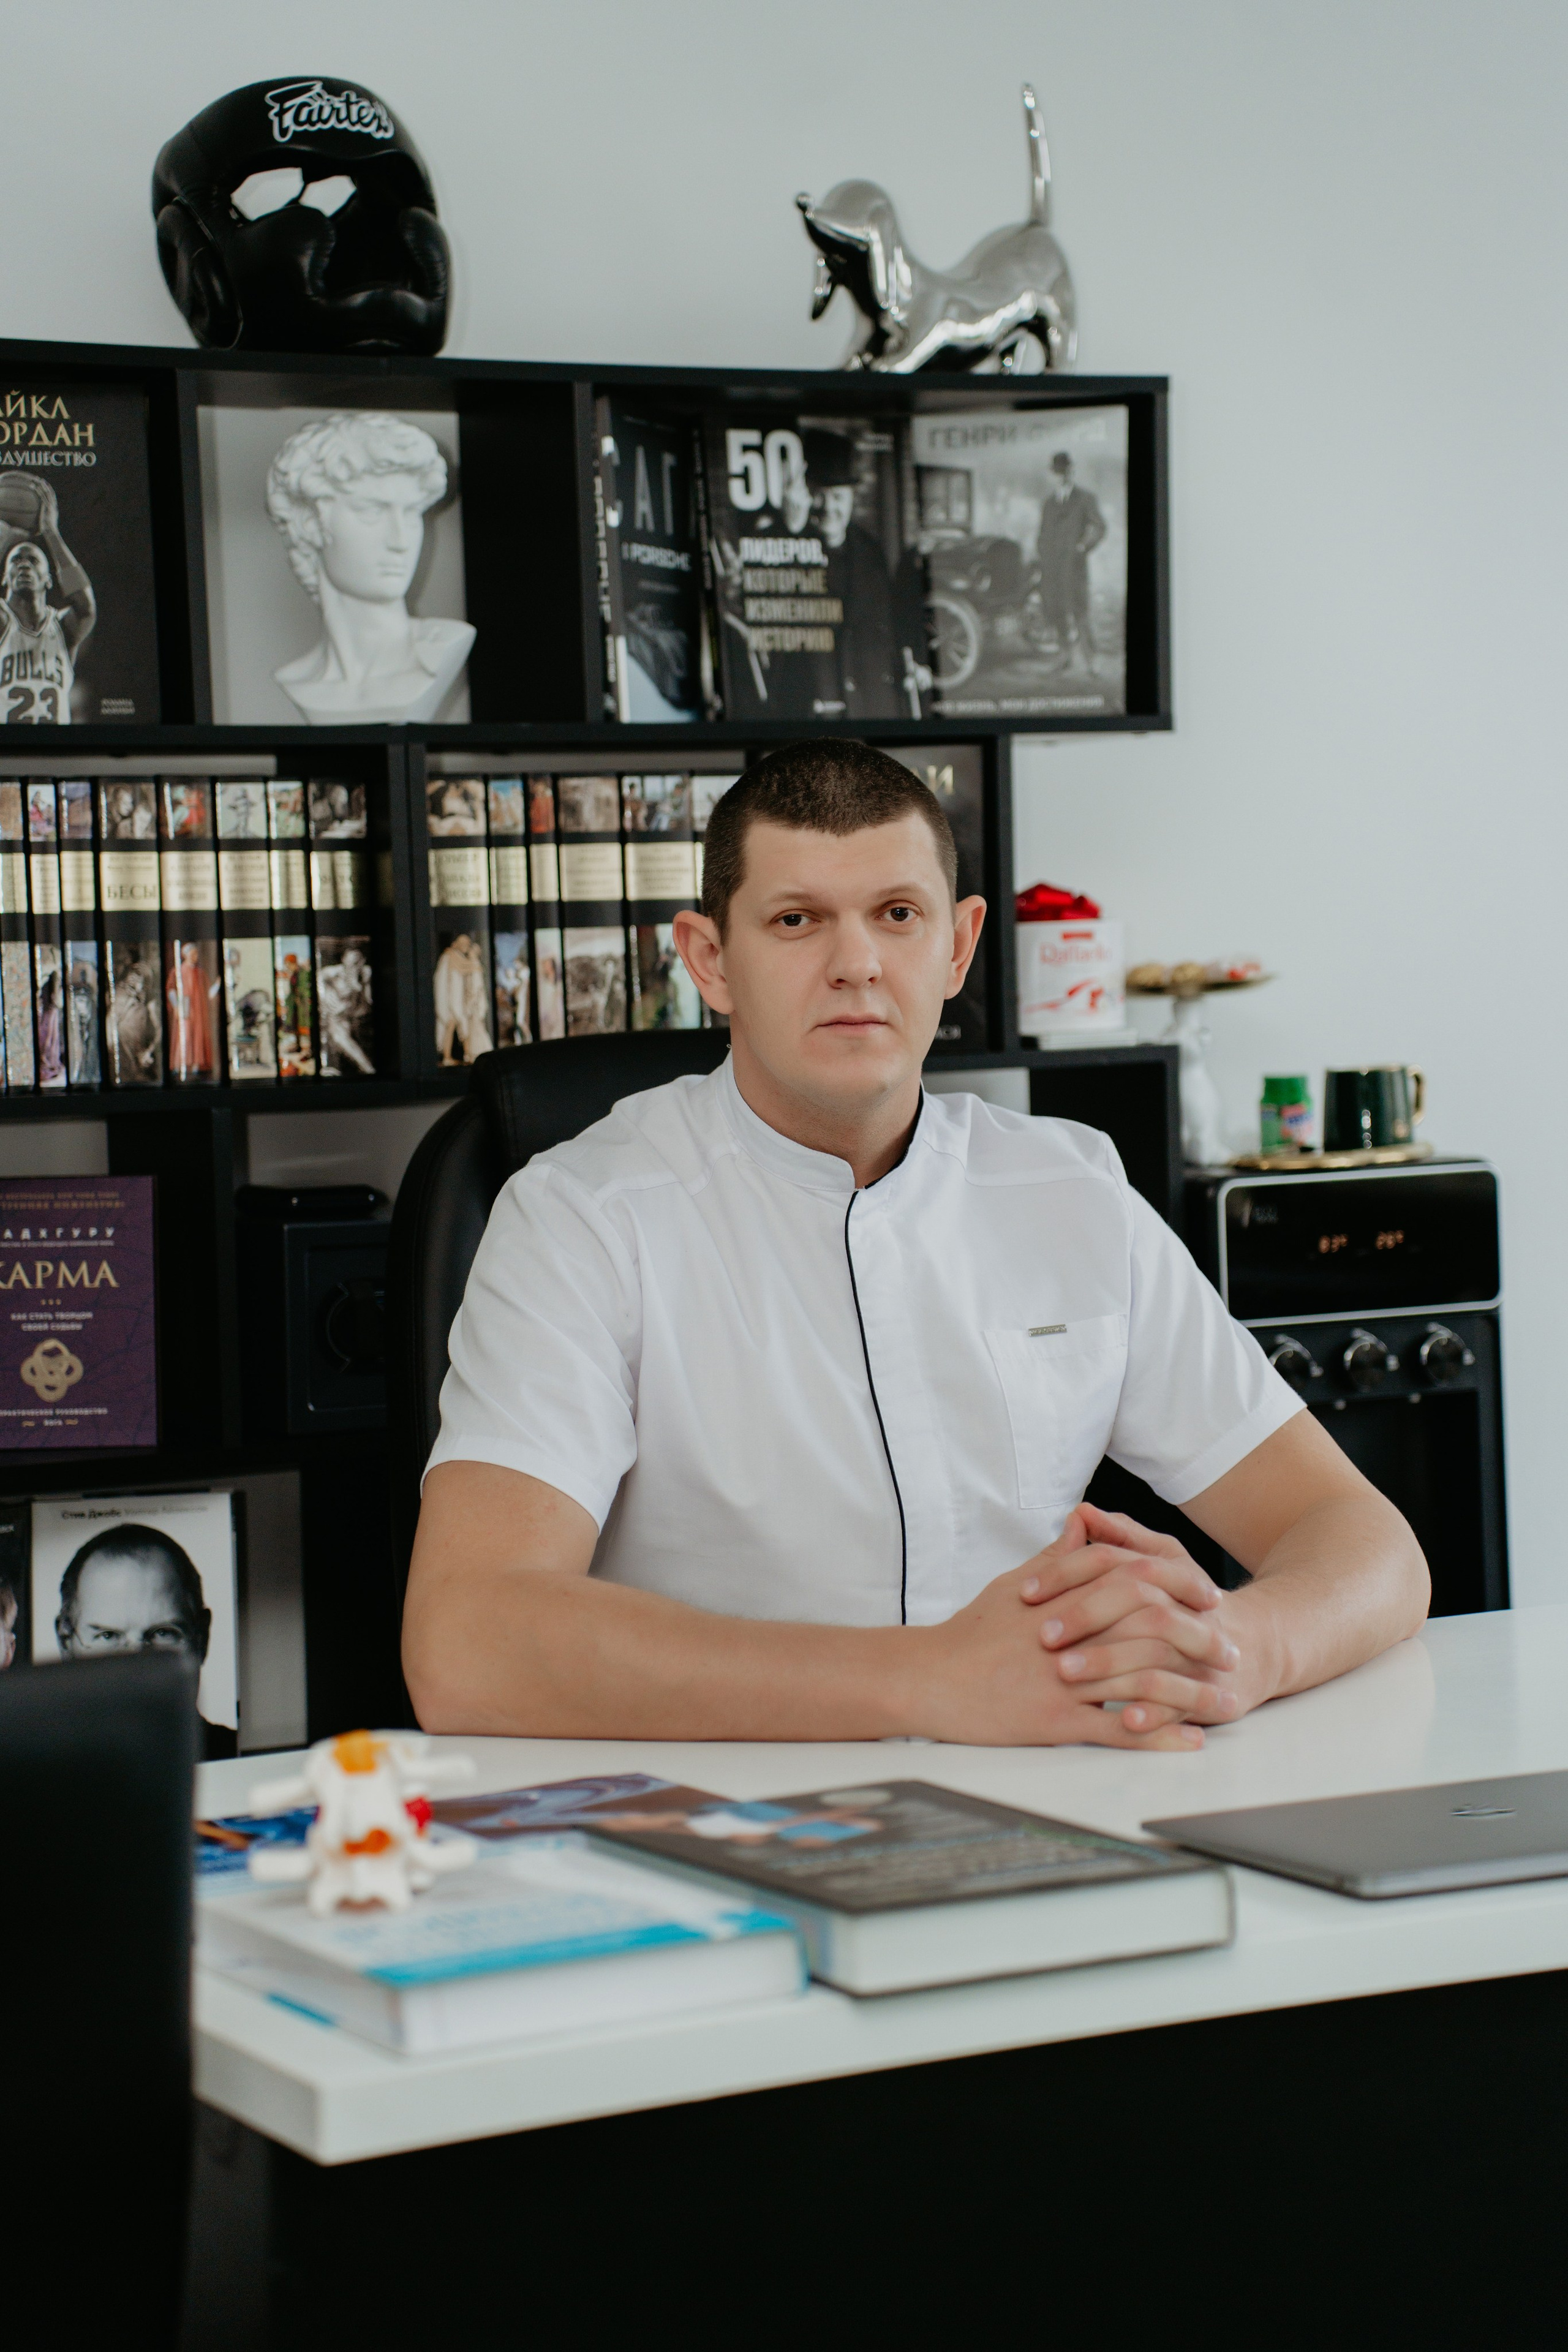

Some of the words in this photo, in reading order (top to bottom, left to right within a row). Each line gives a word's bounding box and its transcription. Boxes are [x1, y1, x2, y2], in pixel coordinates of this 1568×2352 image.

[265, 80, 395, 143] Fairtex
[927, 425, 1017, 448] ГЕНРИ
[0, 450, 97, 467] ДУШЕСТВО
[726, 429, 804, 511] 50
[1, 649, 64, 688] BULLS
[7, 687, 59, 723] 23
[107, 884, 157, 901] БЕСЫ
[62, 1510, 86, 1519] Стив
[88, 1507, 122, 1519] Джобс
